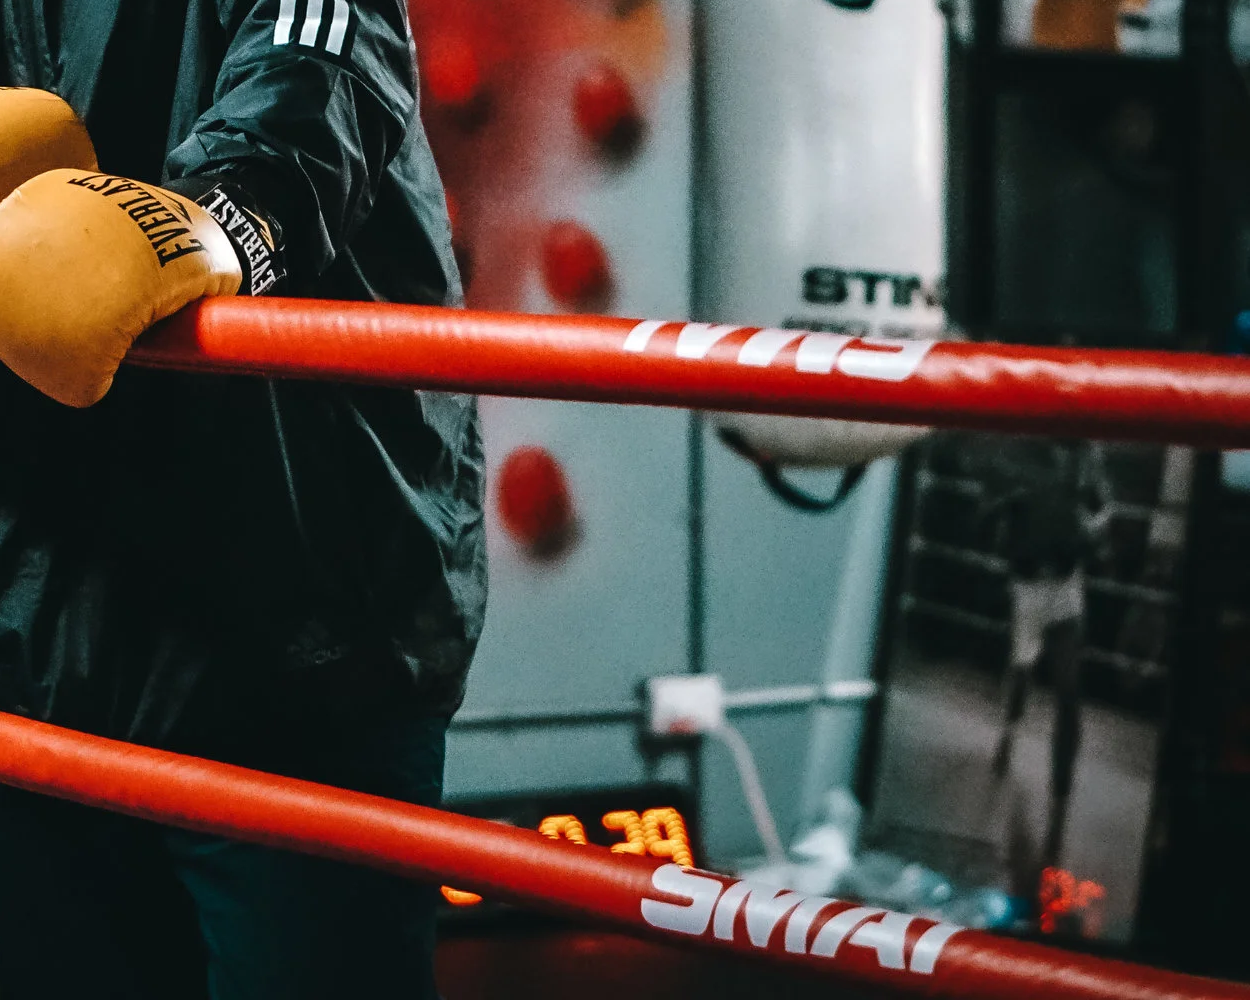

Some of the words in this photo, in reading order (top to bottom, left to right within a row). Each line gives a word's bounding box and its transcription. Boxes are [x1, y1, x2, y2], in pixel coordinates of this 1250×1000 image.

[67, 174, 207, 268] EVERLAST
[202, 188, 276, 297] EVERLAST
[641, 863, 963, 975] SMAI
